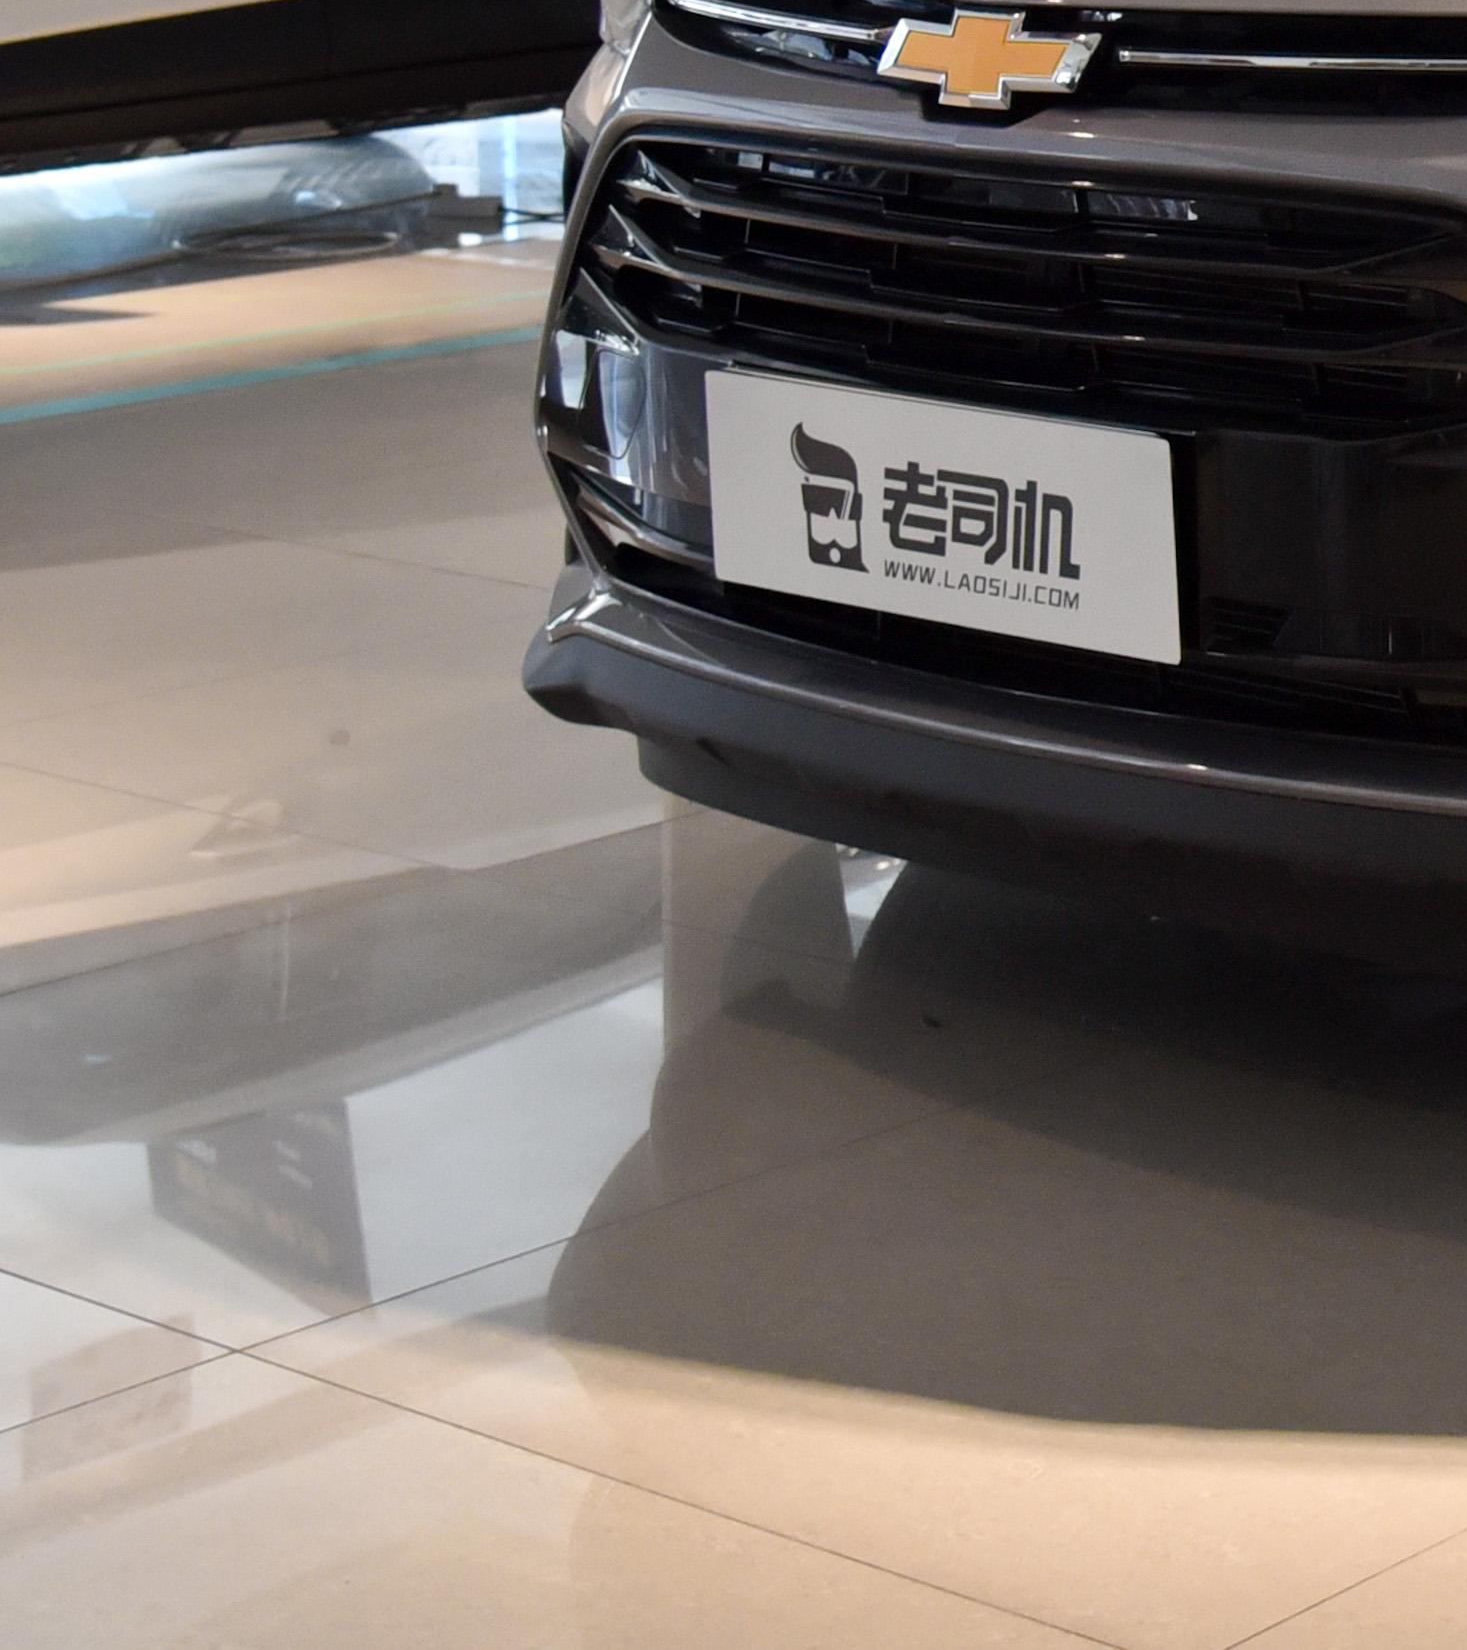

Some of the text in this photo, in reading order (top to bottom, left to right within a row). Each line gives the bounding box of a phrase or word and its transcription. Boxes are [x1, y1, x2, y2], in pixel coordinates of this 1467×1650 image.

[882, 461, 1081, 580] 老司机
[883, 560, 1081, 611] WWW.LAOSIJI.COM
